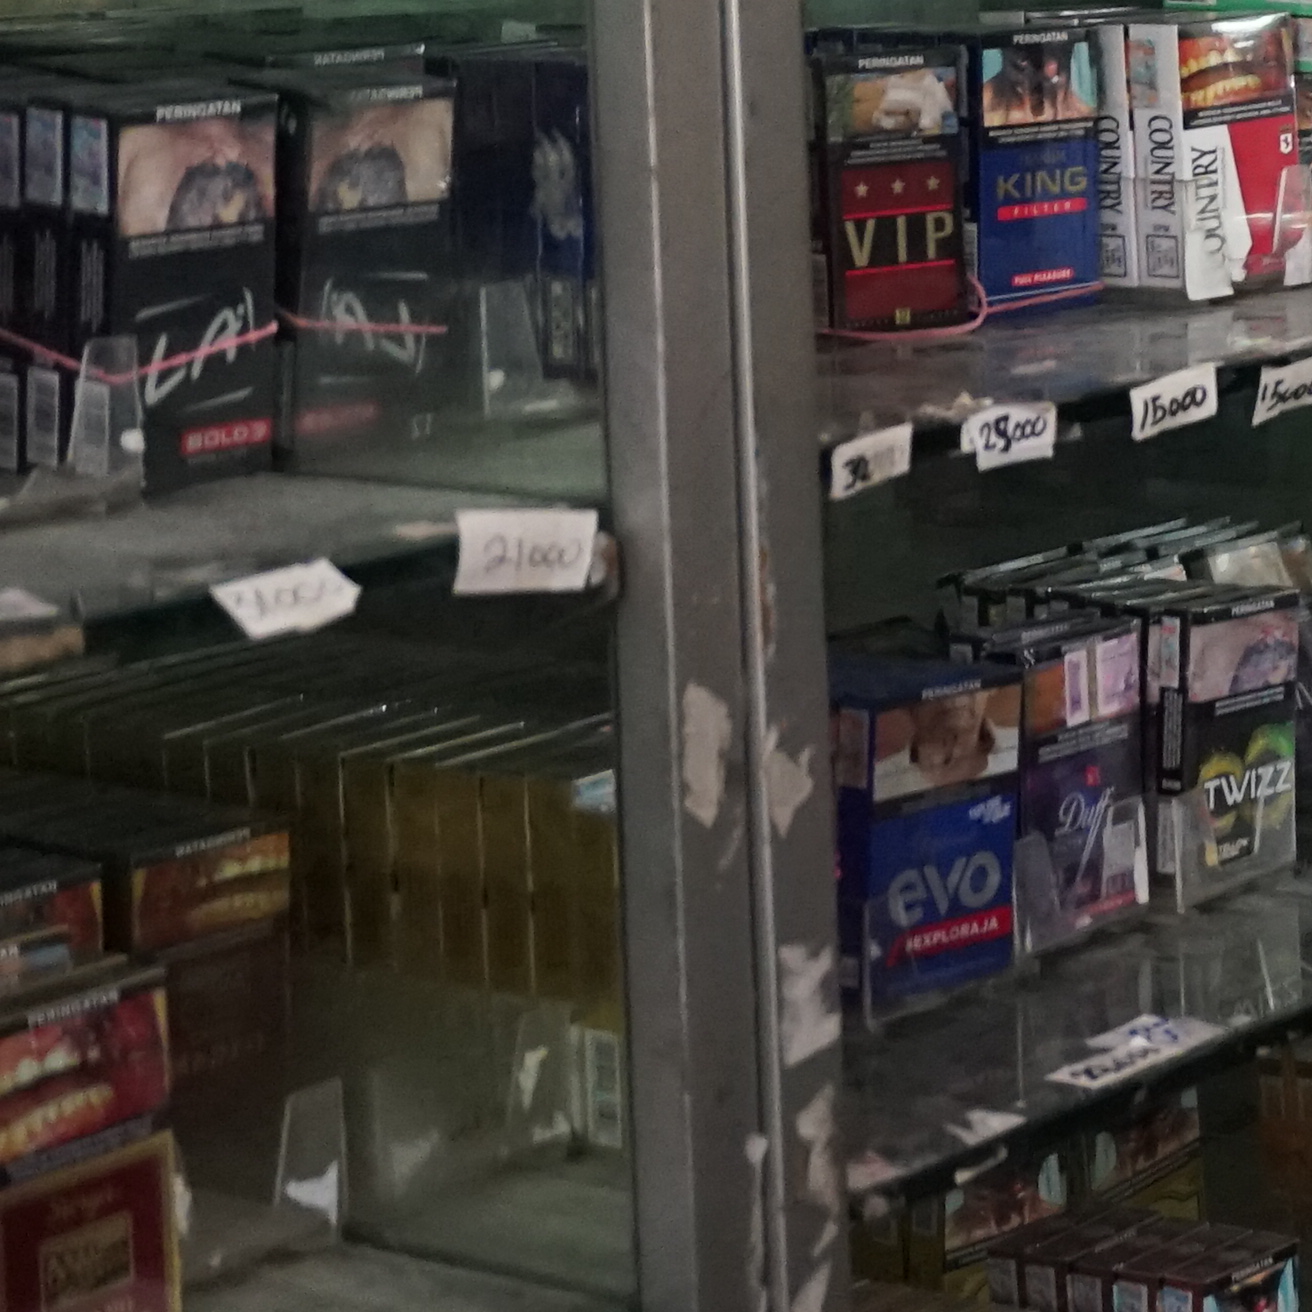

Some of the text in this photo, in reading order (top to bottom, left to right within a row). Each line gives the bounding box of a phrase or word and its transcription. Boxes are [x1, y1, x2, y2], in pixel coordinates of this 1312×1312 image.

[1012, 31, 1069, 46] PERINGATAN
[858, 55, 924, 70] PERINGATAN
[155, 99, 242, 122] PERINGATAN
[996, 165, 1089, 200] KING
[1147, 115, 1175, 215] COUNTRY
[1012, 201, 1073, 217] FILTER
[844, 211, 955, 269] VIP
[1140, 383, 1208, 432] 15000
[1206, 760, 1293, 810] TWIZZ
[887, 849, 1001, 928] evo
